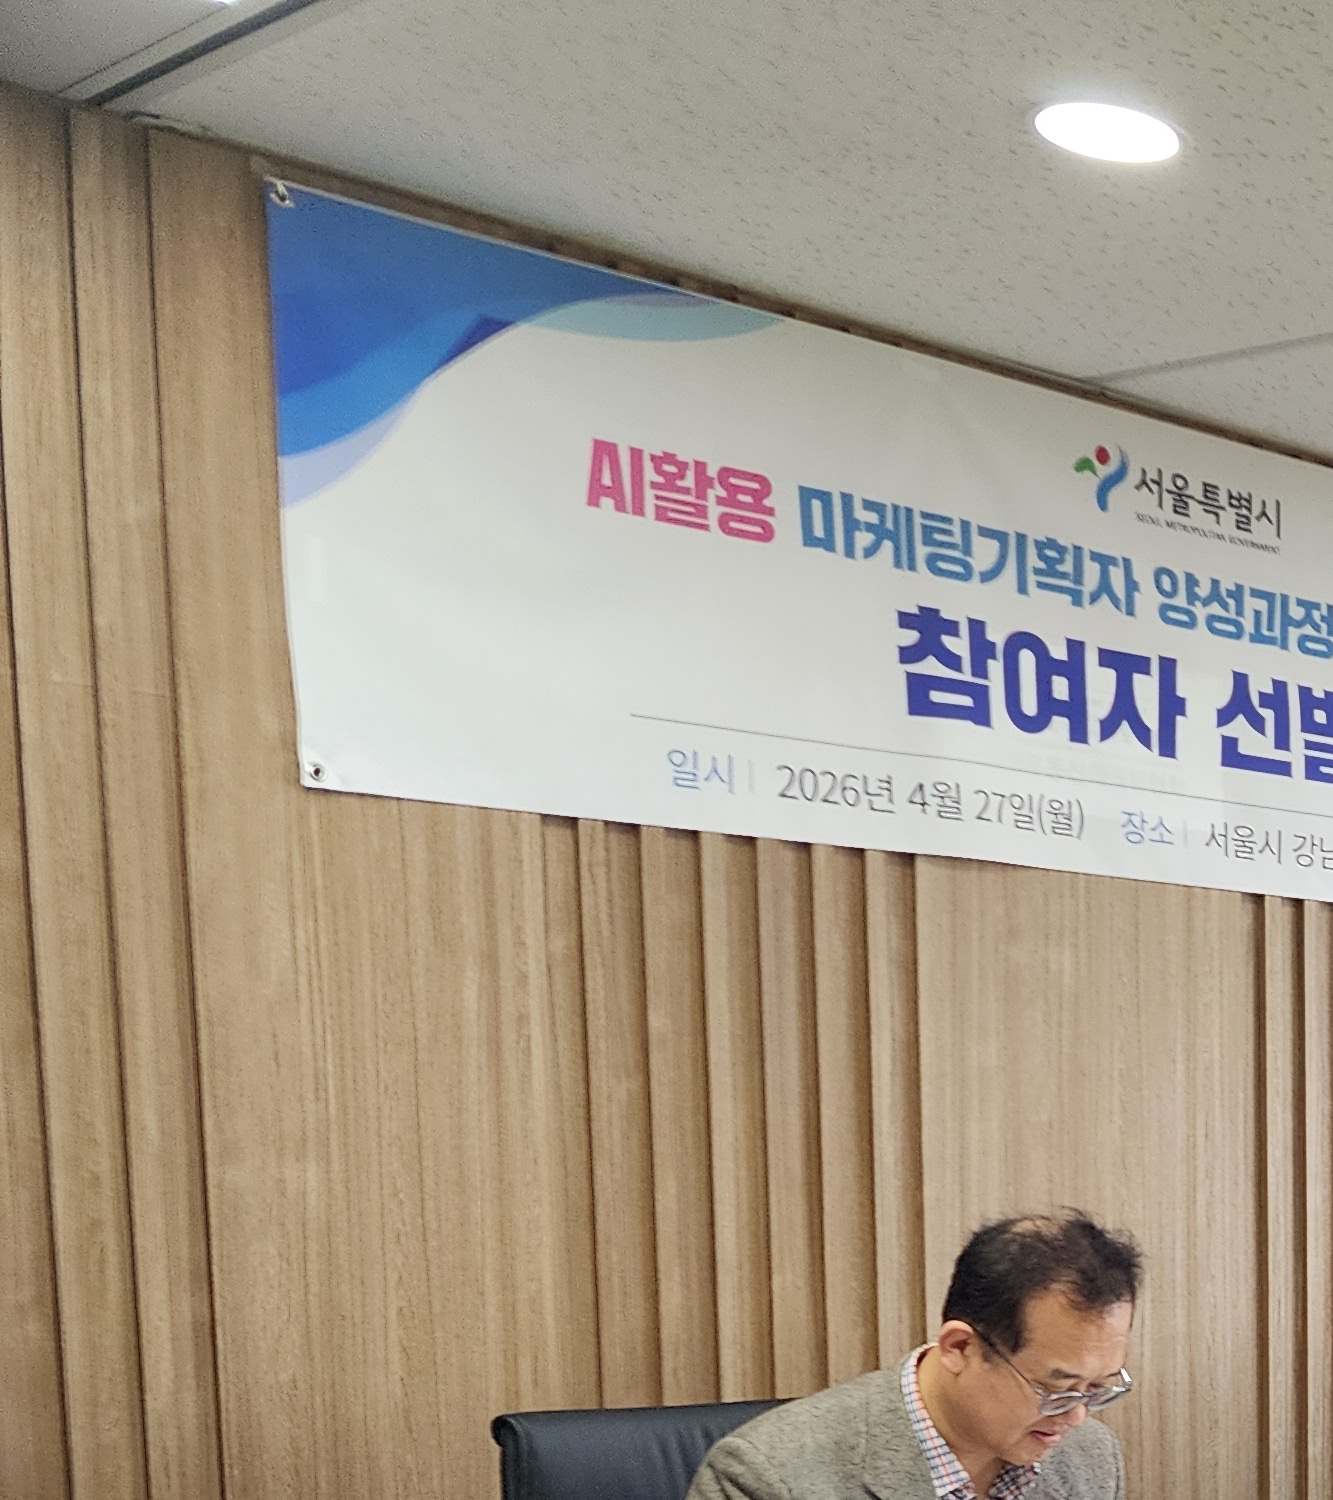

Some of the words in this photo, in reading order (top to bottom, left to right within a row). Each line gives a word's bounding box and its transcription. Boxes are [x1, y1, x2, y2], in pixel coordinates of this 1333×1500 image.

[587, 438, 777, 544] AI활용
[798, 485, 1140, 619] 마케팅기획자
[1134, 467, 1281, 540] 서울특별시
[896, 604, 1188, 760] 참여자
[667, 748, 735, 795] 일시
[777, 764, 896, 815] 2026년
[907, 781, 965, 822] 4월
[974, 788, 1085, 841] 27일(월)
[1120, 810, 1176, 846] 장소
[1204, 821, 1283, 865] 서울시
